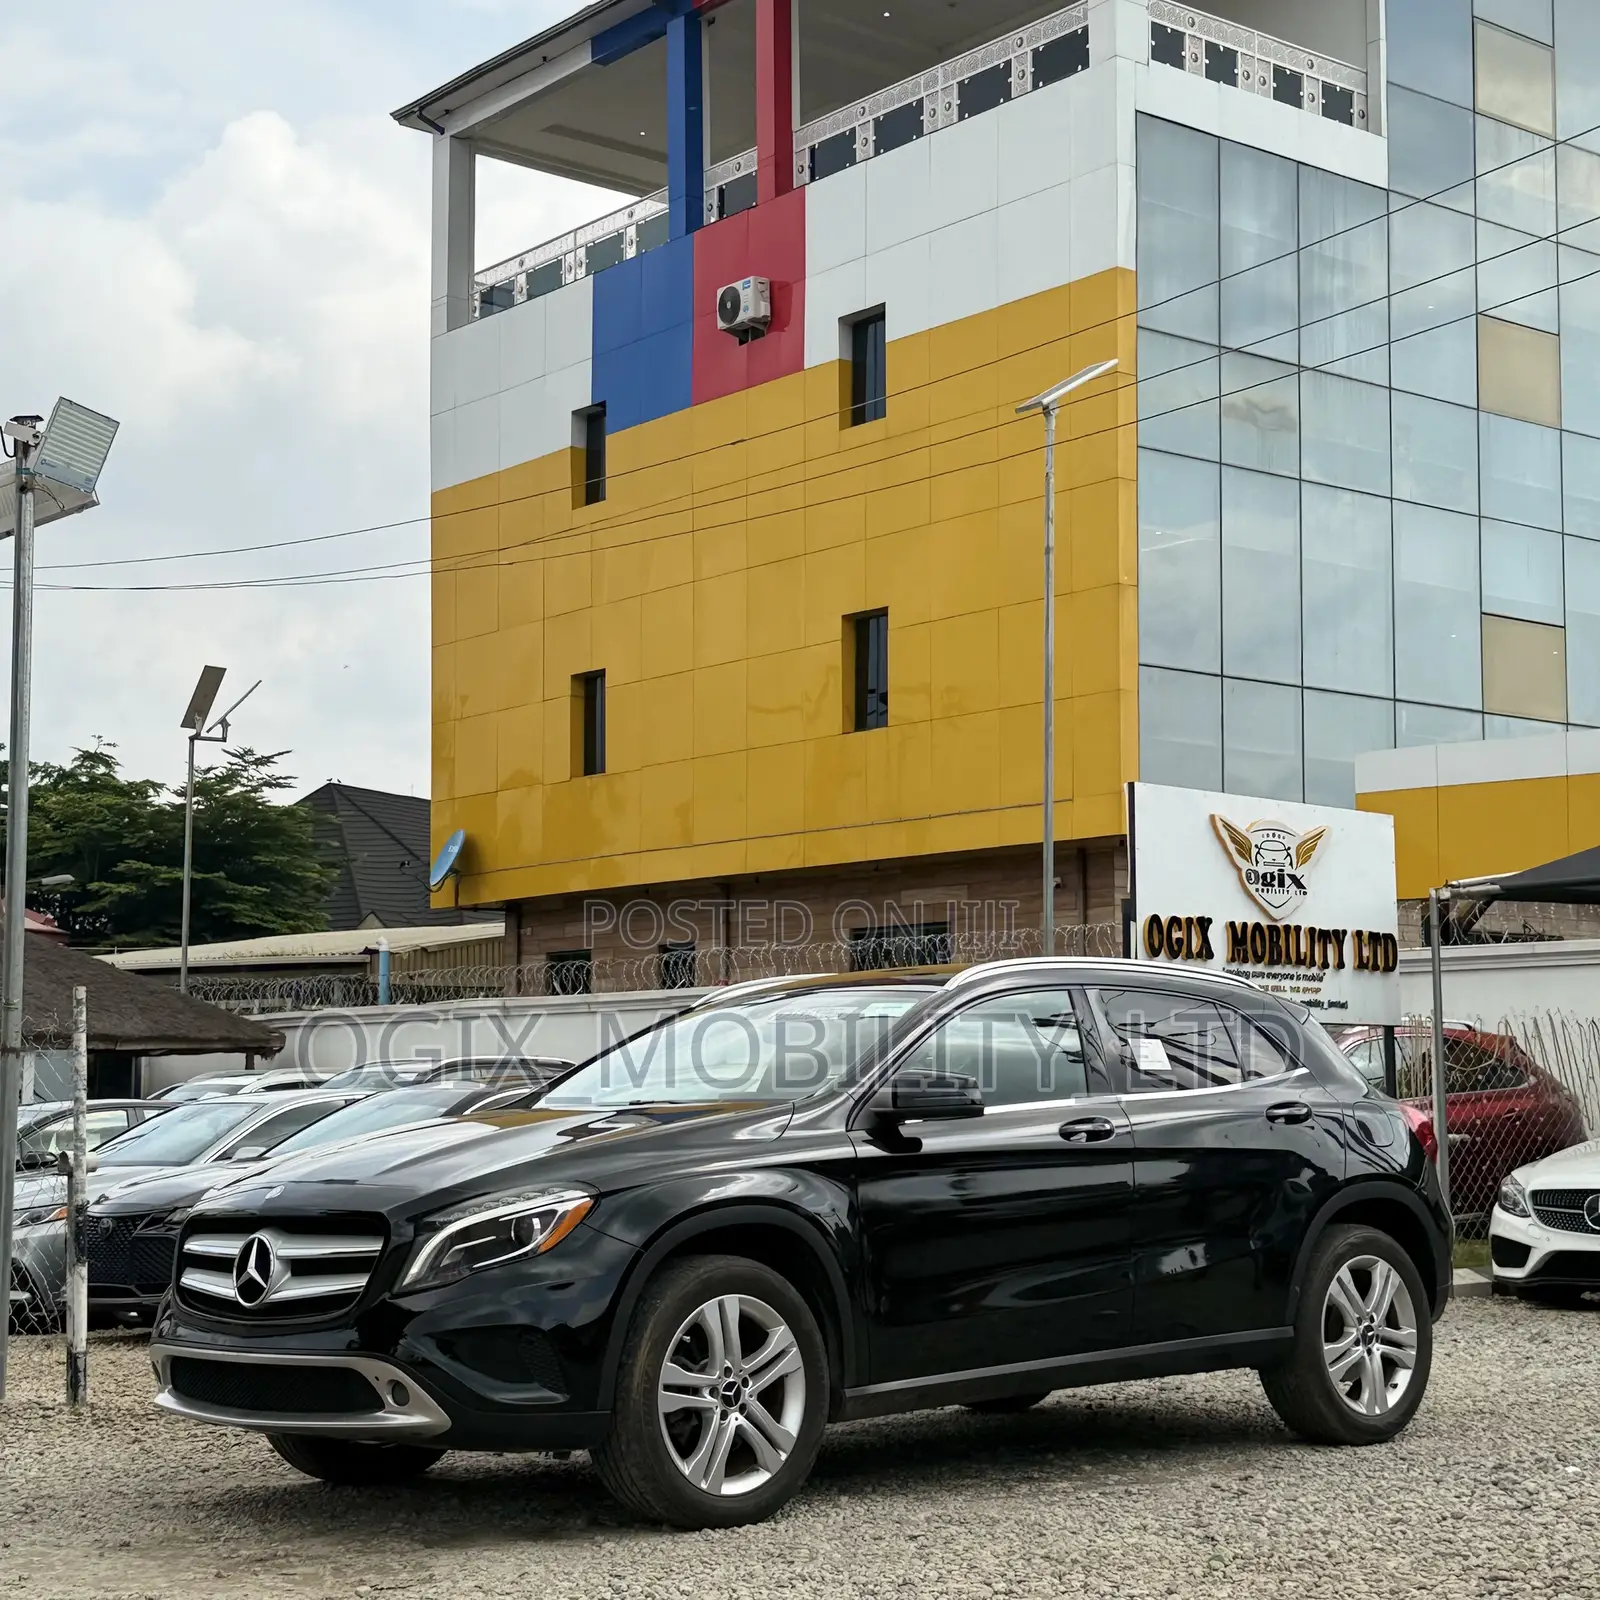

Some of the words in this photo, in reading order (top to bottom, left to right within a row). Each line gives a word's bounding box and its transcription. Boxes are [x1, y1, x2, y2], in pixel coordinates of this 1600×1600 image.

[1143, 913, 1215, 961] OGIX
[1225, 920, 1347, 970] MOBILITY
[1352, 929, 1398, 972] LTD
